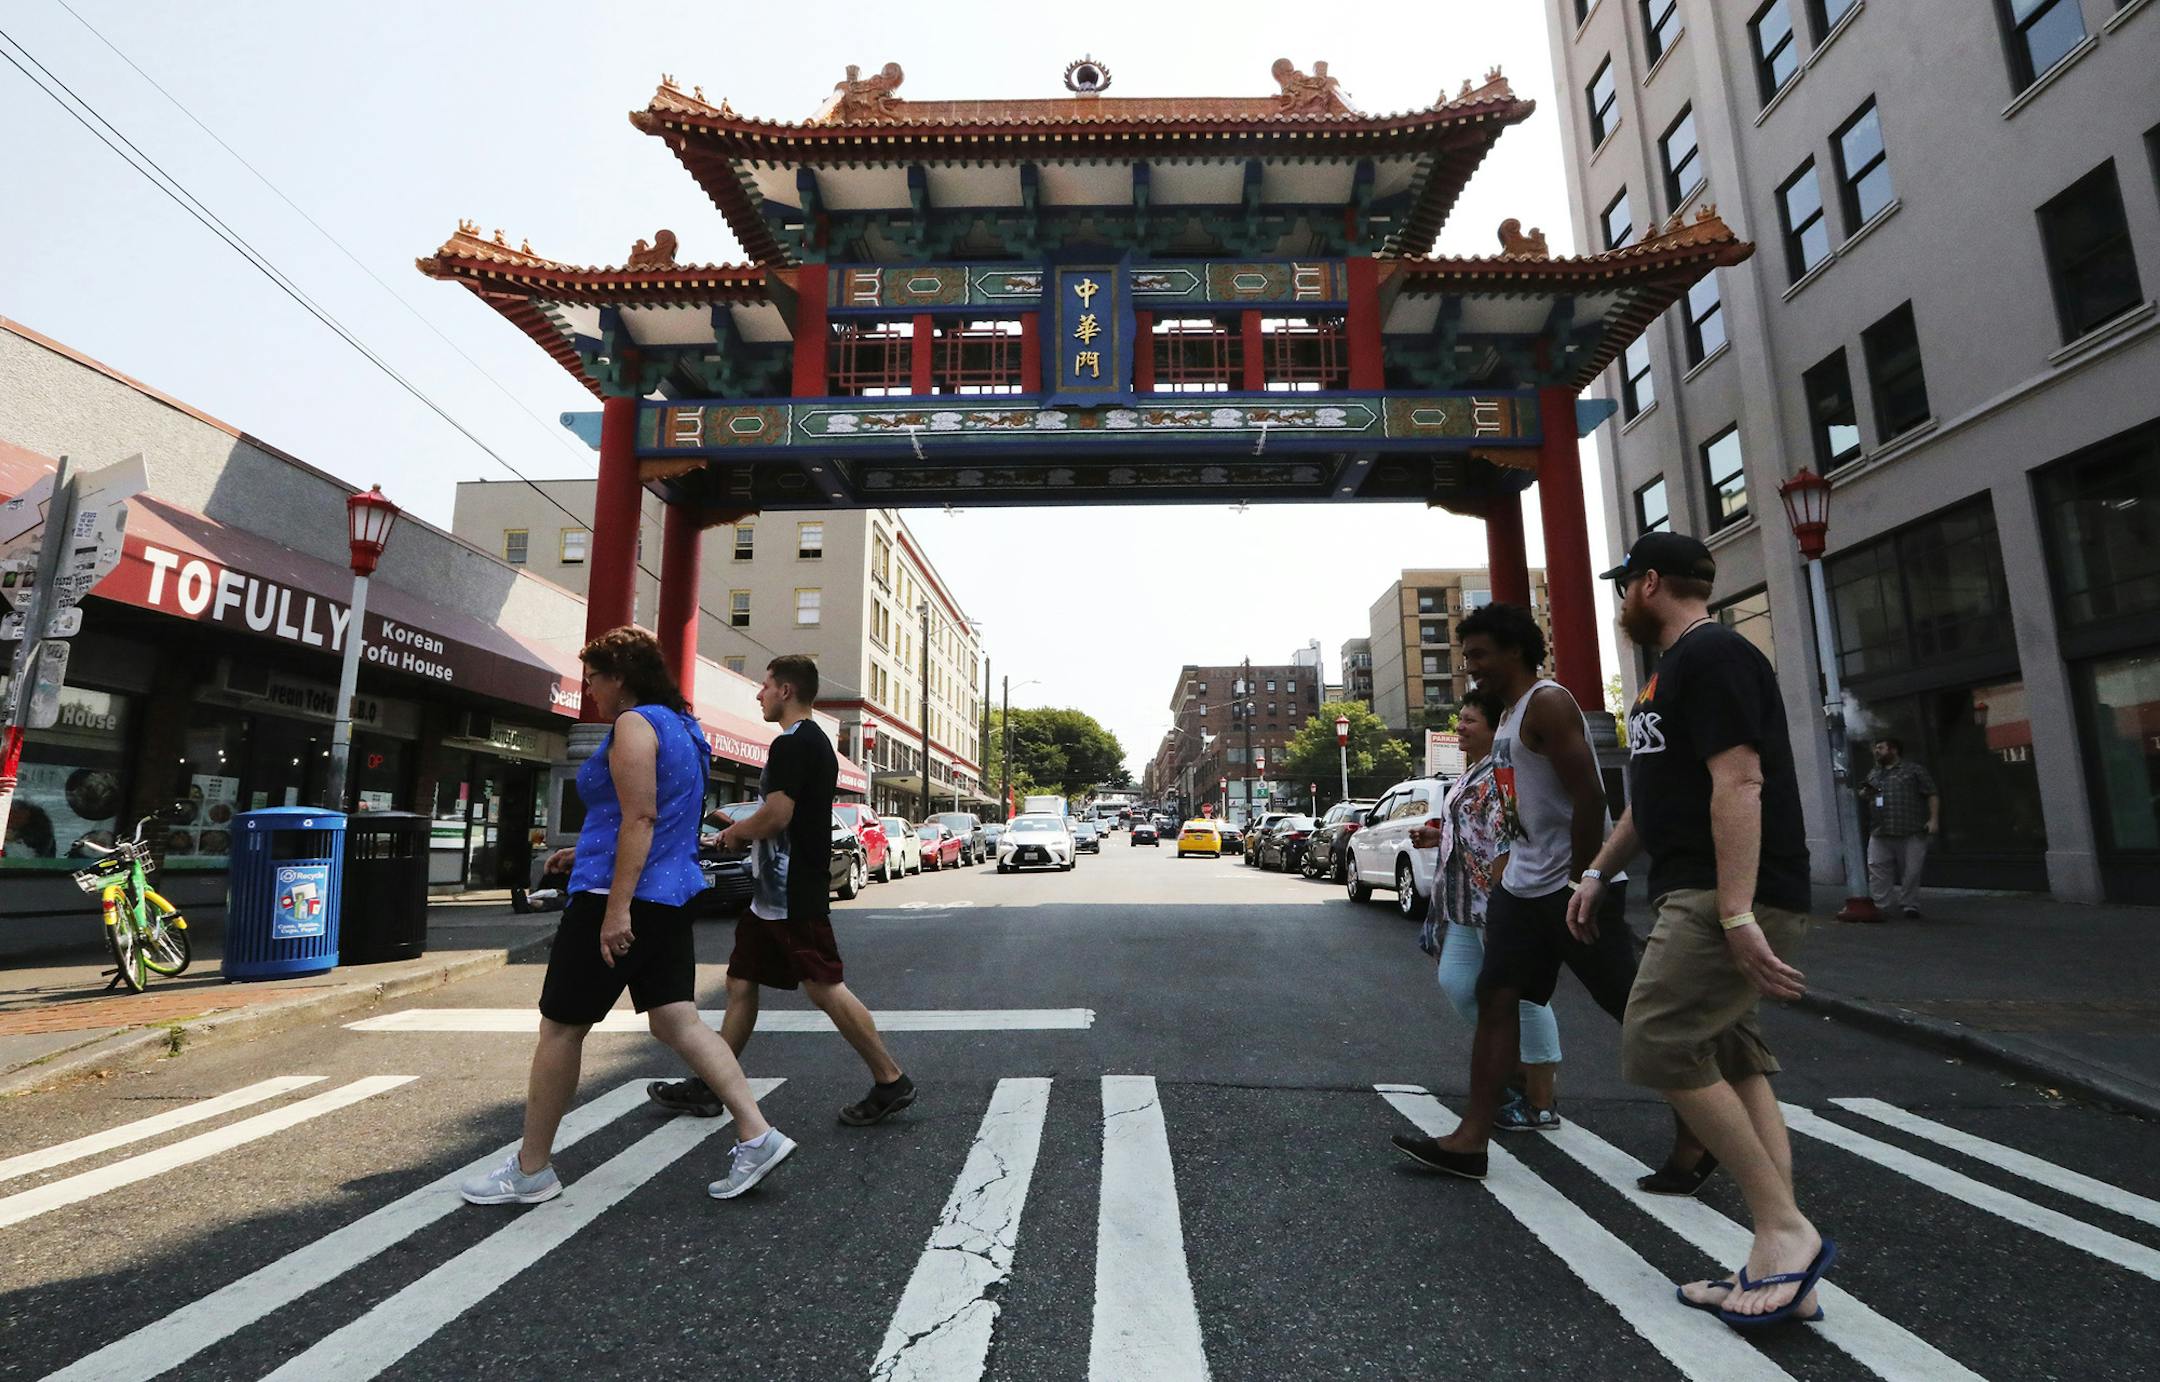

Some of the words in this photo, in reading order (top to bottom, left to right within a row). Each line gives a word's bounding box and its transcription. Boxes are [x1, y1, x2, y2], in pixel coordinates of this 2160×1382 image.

[1073, 278, 1101, 378] 中華門
[144, 546, 351, 651] TOFULLY
[382, 620, 444, 655] Korean
[402, 651, 454, 681] House
[267, 684, 304, 708] rean
[550, 682, 582, 710] Seatt
[63, 706, 116, 730] House
[740, 742, 760, 761] FOOD
[296, 872, 325, 881] Recycle
